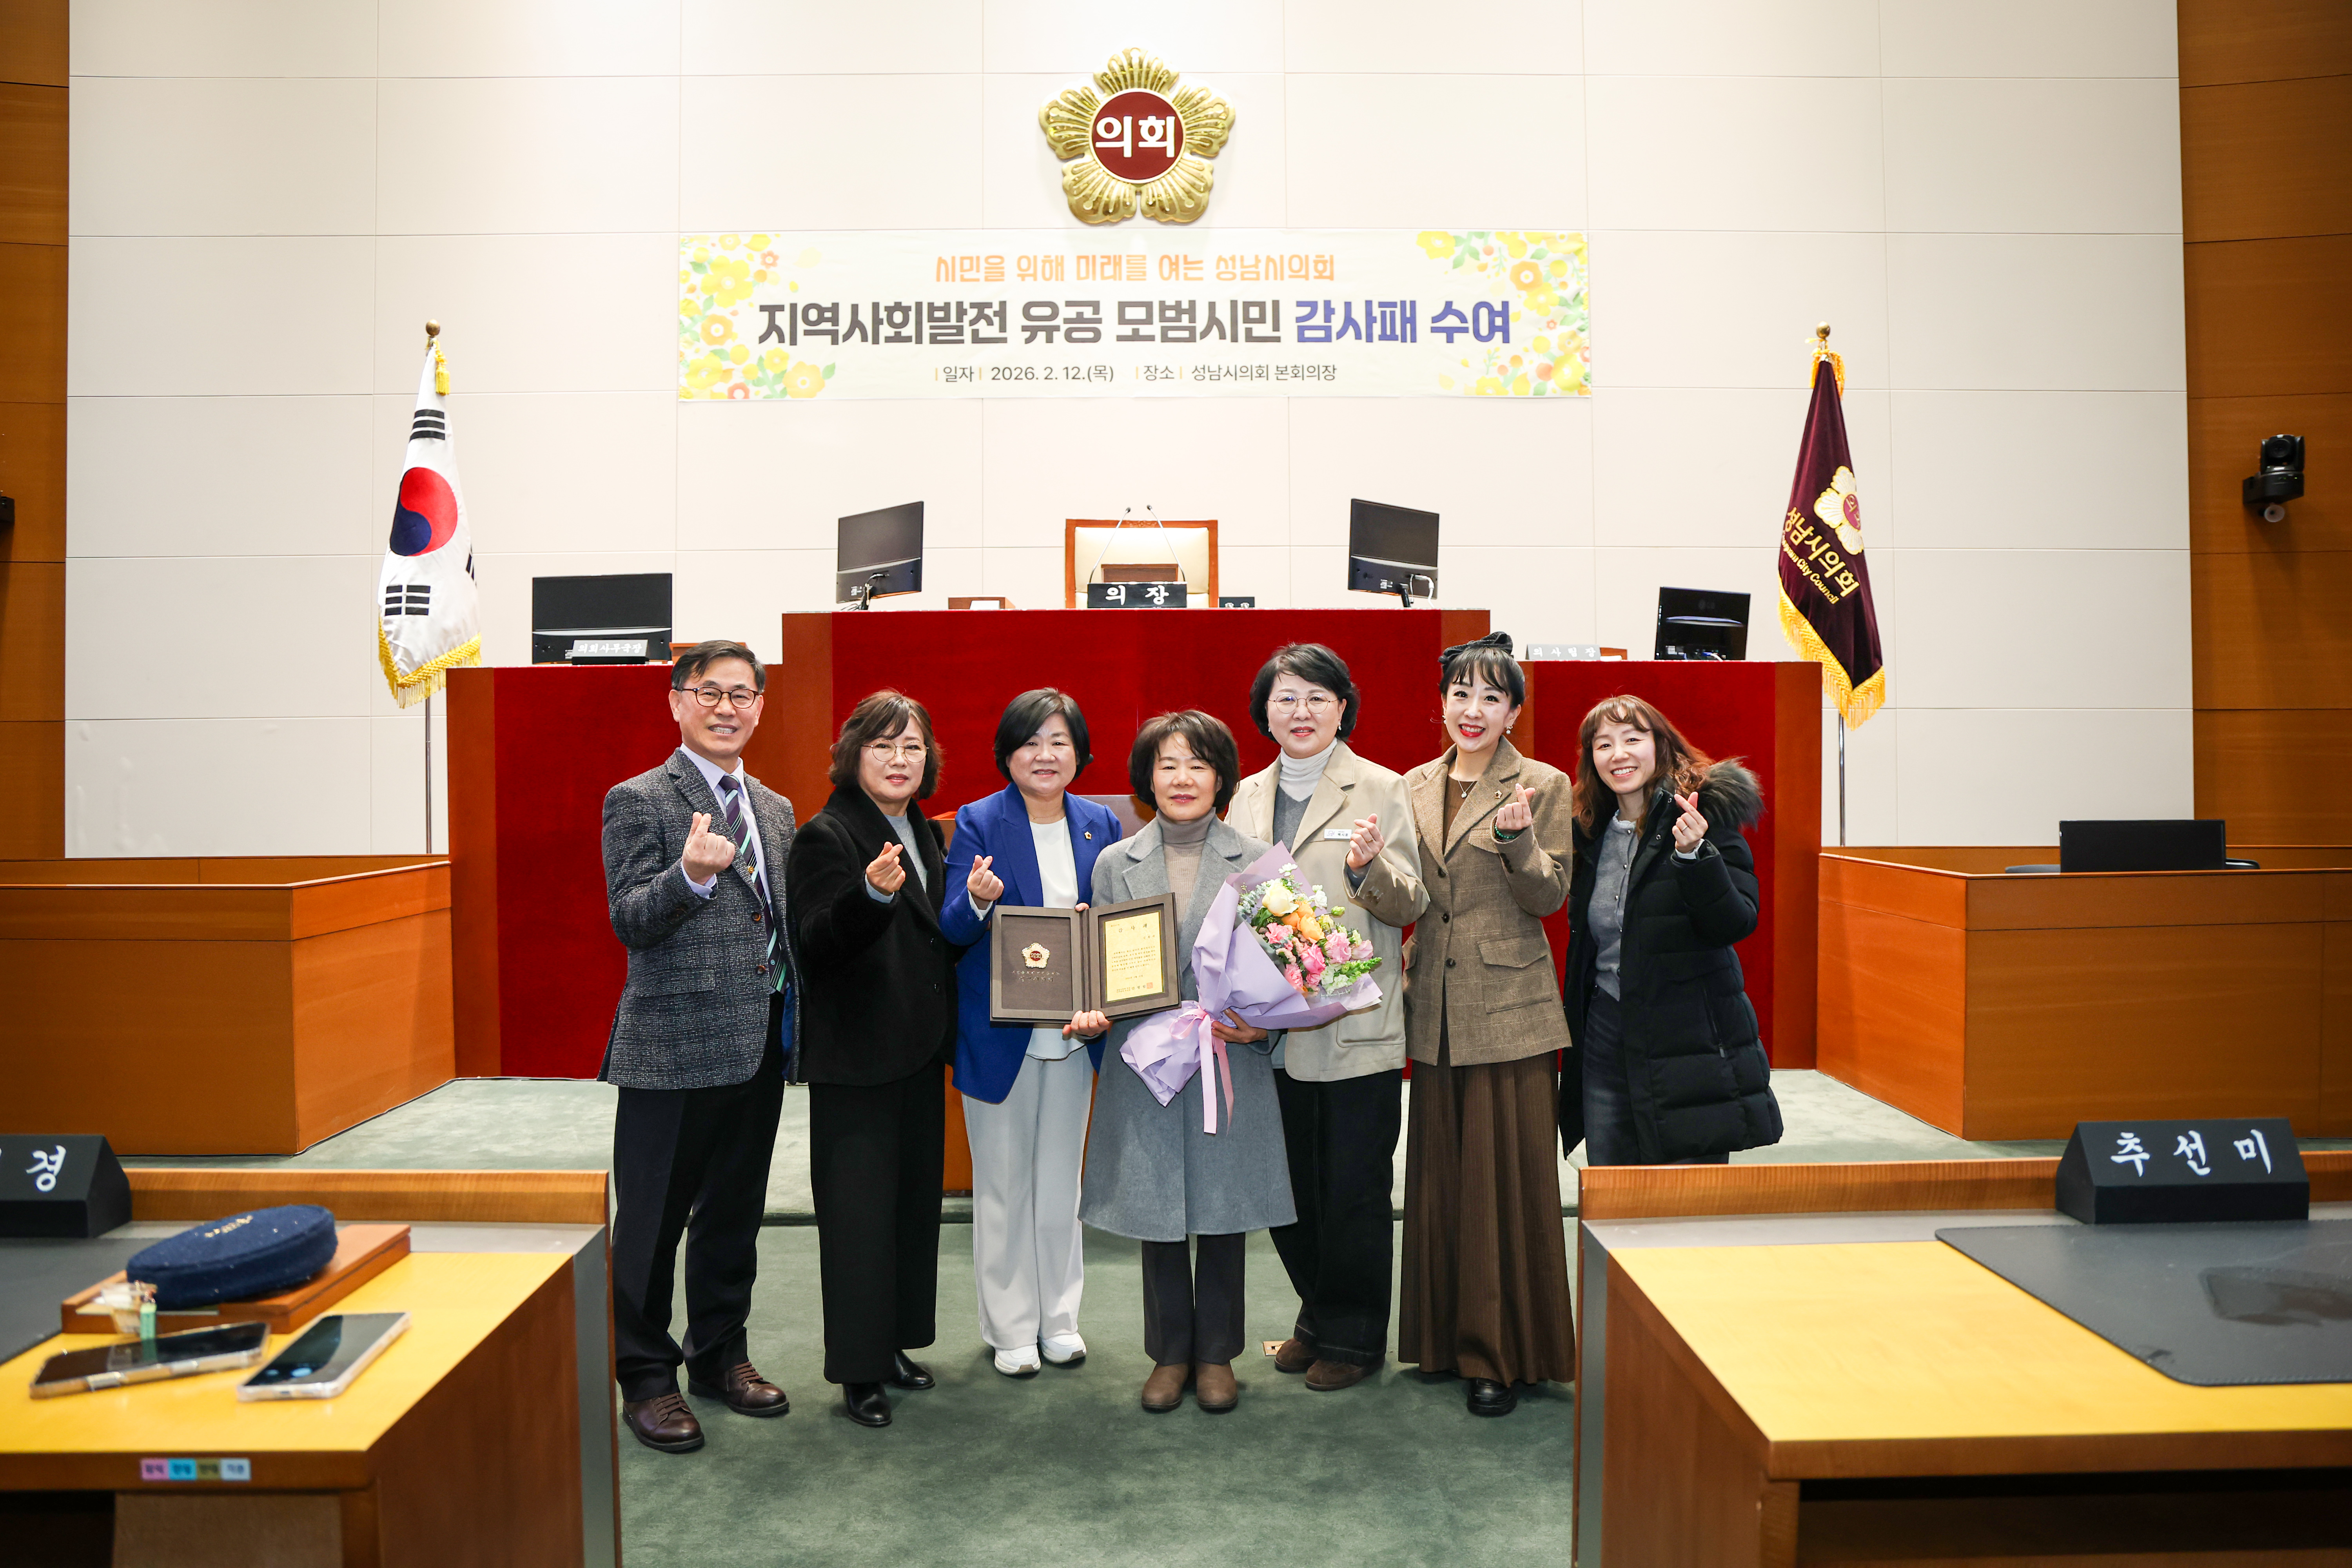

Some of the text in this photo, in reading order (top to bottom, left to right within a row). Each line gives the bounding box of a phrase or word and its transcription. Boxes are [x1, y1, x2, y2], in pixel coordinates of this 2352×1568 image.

[1095, 115, 1176, 158] 의회
[935, 254, 1335, 283] 시민을 위해 미래를 여는 성남시의회
[758, 300, 1511, 346] 지역사회발전 유공 모범시민 감사패 수여
[943, 365, 1114, 383] 일자 2026. 2. 12.(목)
[1144, 365, 1338, 381] 장소 성남시의회 본회의장
[1785, 507, 1860, 597] 성남시의회
[1797, 558, 1813, 576] City
[1809, 573, 1840, 604] Council
[577, 642, 642, 654] 의회사무국장
